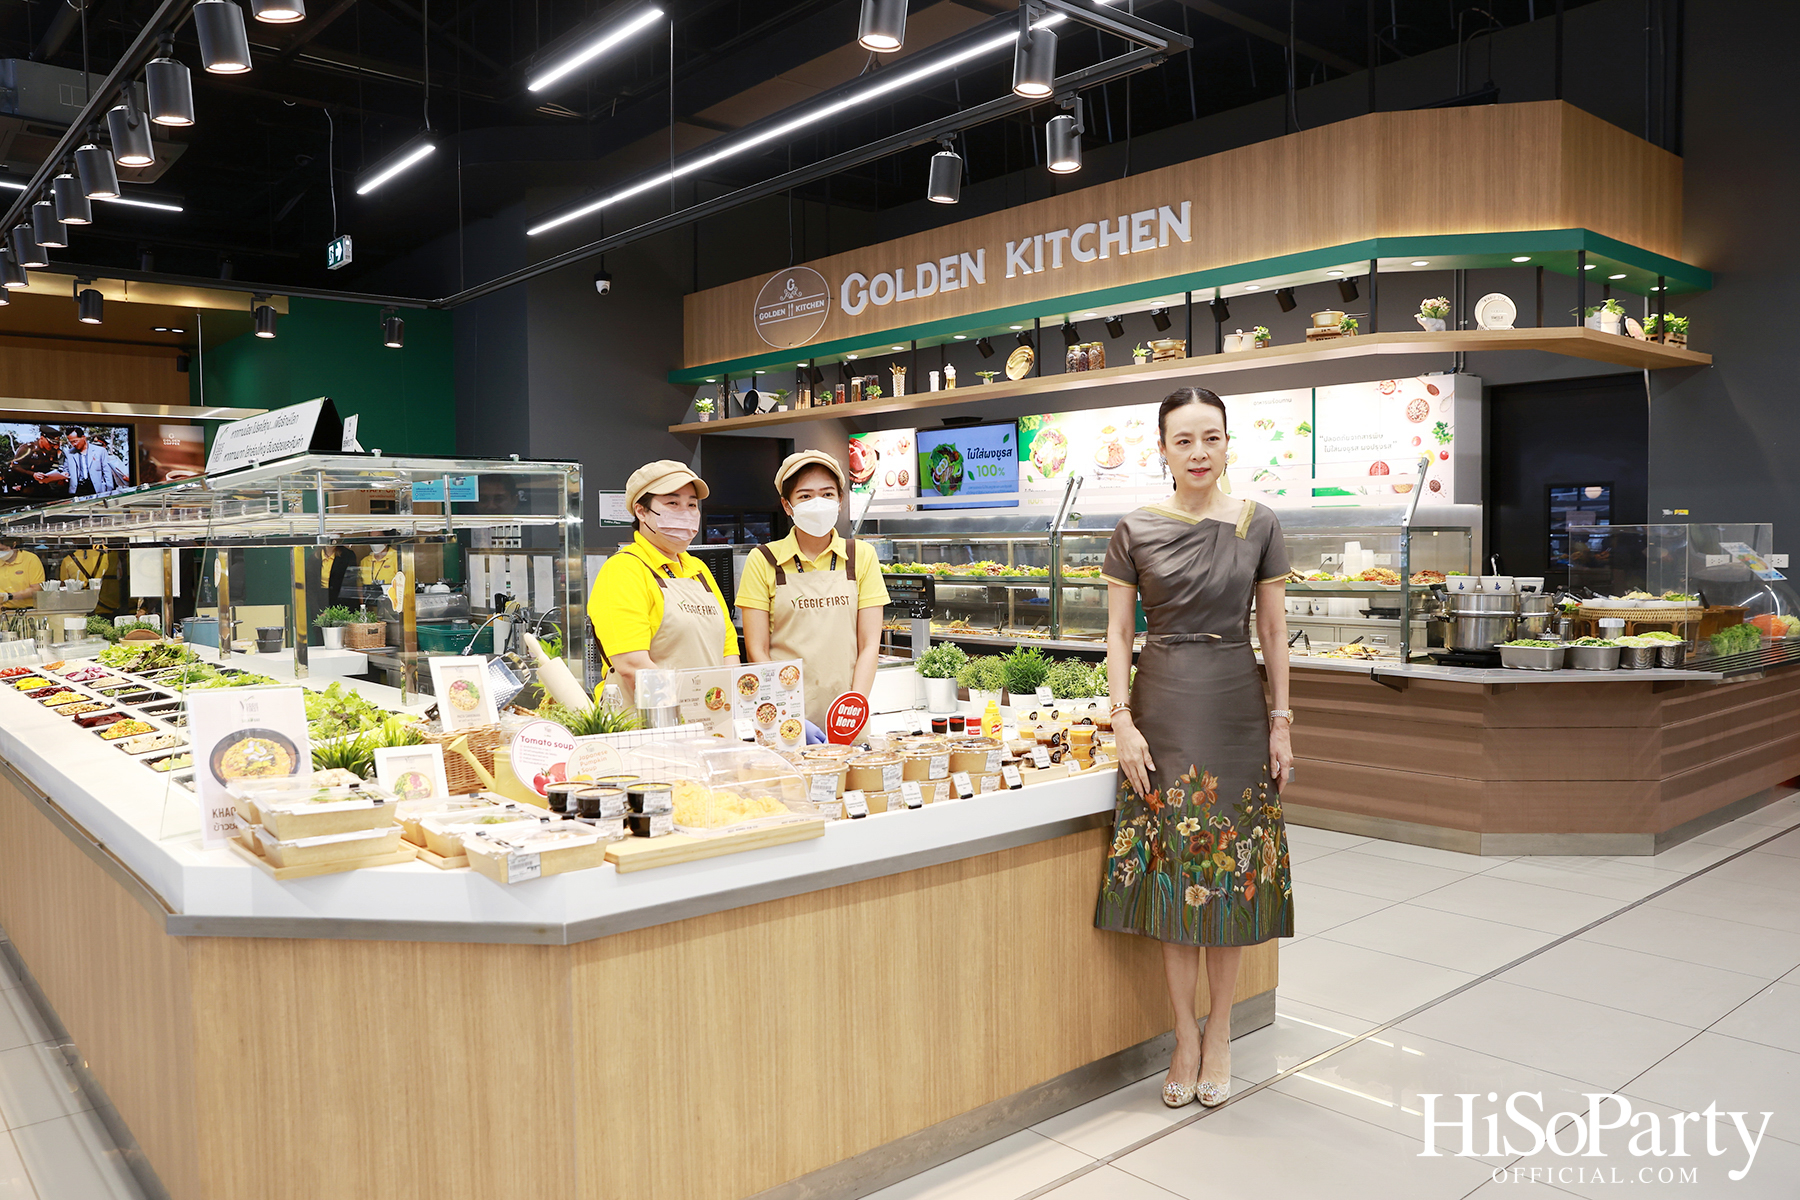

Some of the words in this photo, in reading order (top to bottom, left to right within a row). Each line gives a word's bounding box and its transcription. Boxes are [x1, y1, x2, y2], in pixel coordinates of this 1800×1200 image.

[840, 247, 986, 317] GOLDEN
[1005, 201, 1194, 278] KITCHEN
[759, 308, 786, 321] GOLDEN
[795, 299, 825, 312] KITCHEN
[966, 446, 1013, 462] ไม่ใส่ผงชูรส
[976, 464, 1006, 478] 100%
[677, 599, 703, 616] VEGGIE
[702, 604, 719, 616] FIRST
[791, 594, 825, 610] VEGGIE
[826, 595, 850, 608] FIRST
[837, 702, 862, 718] Order
[836, 715, 857, 728] Here
[520, 735, 552, 747] Tomato
[554, 741, 575, 751] soup
[578, 749, 609, 761] Japanese
[579, 756, 608, 767] Pumpkin
[581, 765, 598, 774] Soup
